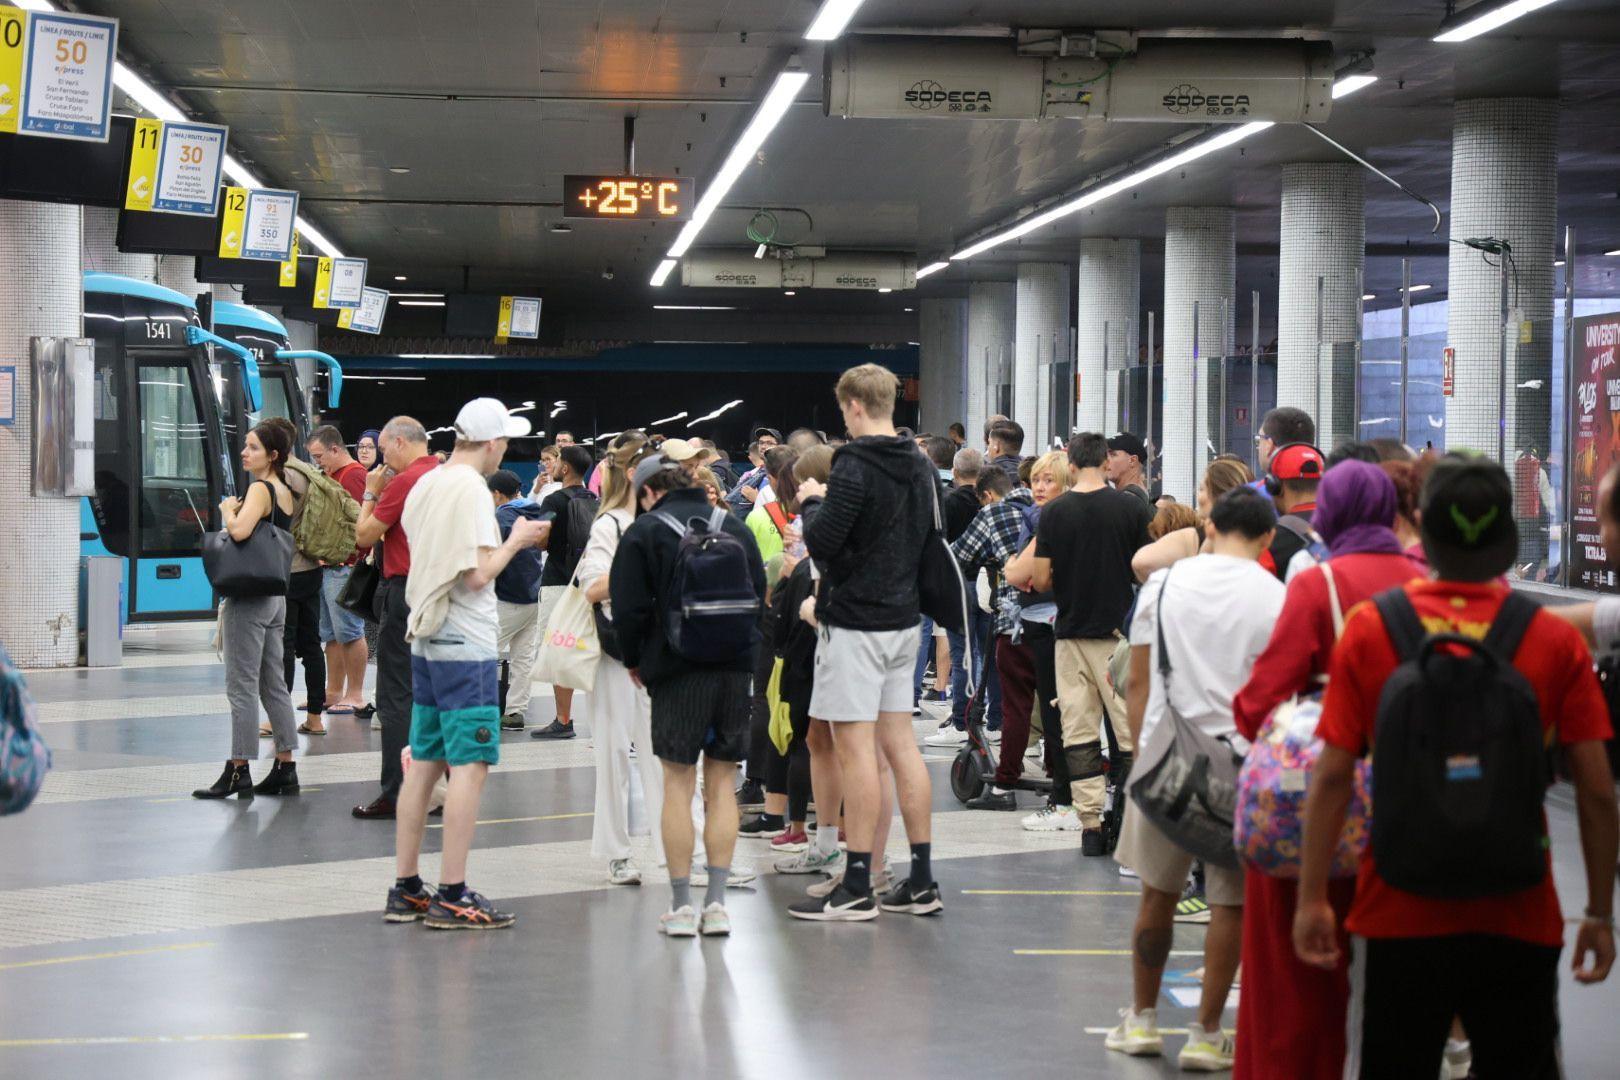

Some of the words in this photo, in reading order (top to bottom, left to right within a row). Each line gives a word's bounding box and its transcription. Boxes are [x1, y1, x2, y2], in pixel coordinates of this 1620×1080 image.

[0, 17, 22, 48] 0
[55, 37, 88, 65] 50
[904, 90, 992, 103] SODECA
[1162, 94, 1250, 107] SODECA
[139, 127, 159, 150] 11
[179, 144, 203, 164] 30
[228, 194, 246, 212] 12
[259, 228, 278, 240] 350
[319, 261, 331, 273] 14
[502, 300, 511, 310] 16
[145, 322, 172, 340] 1541
